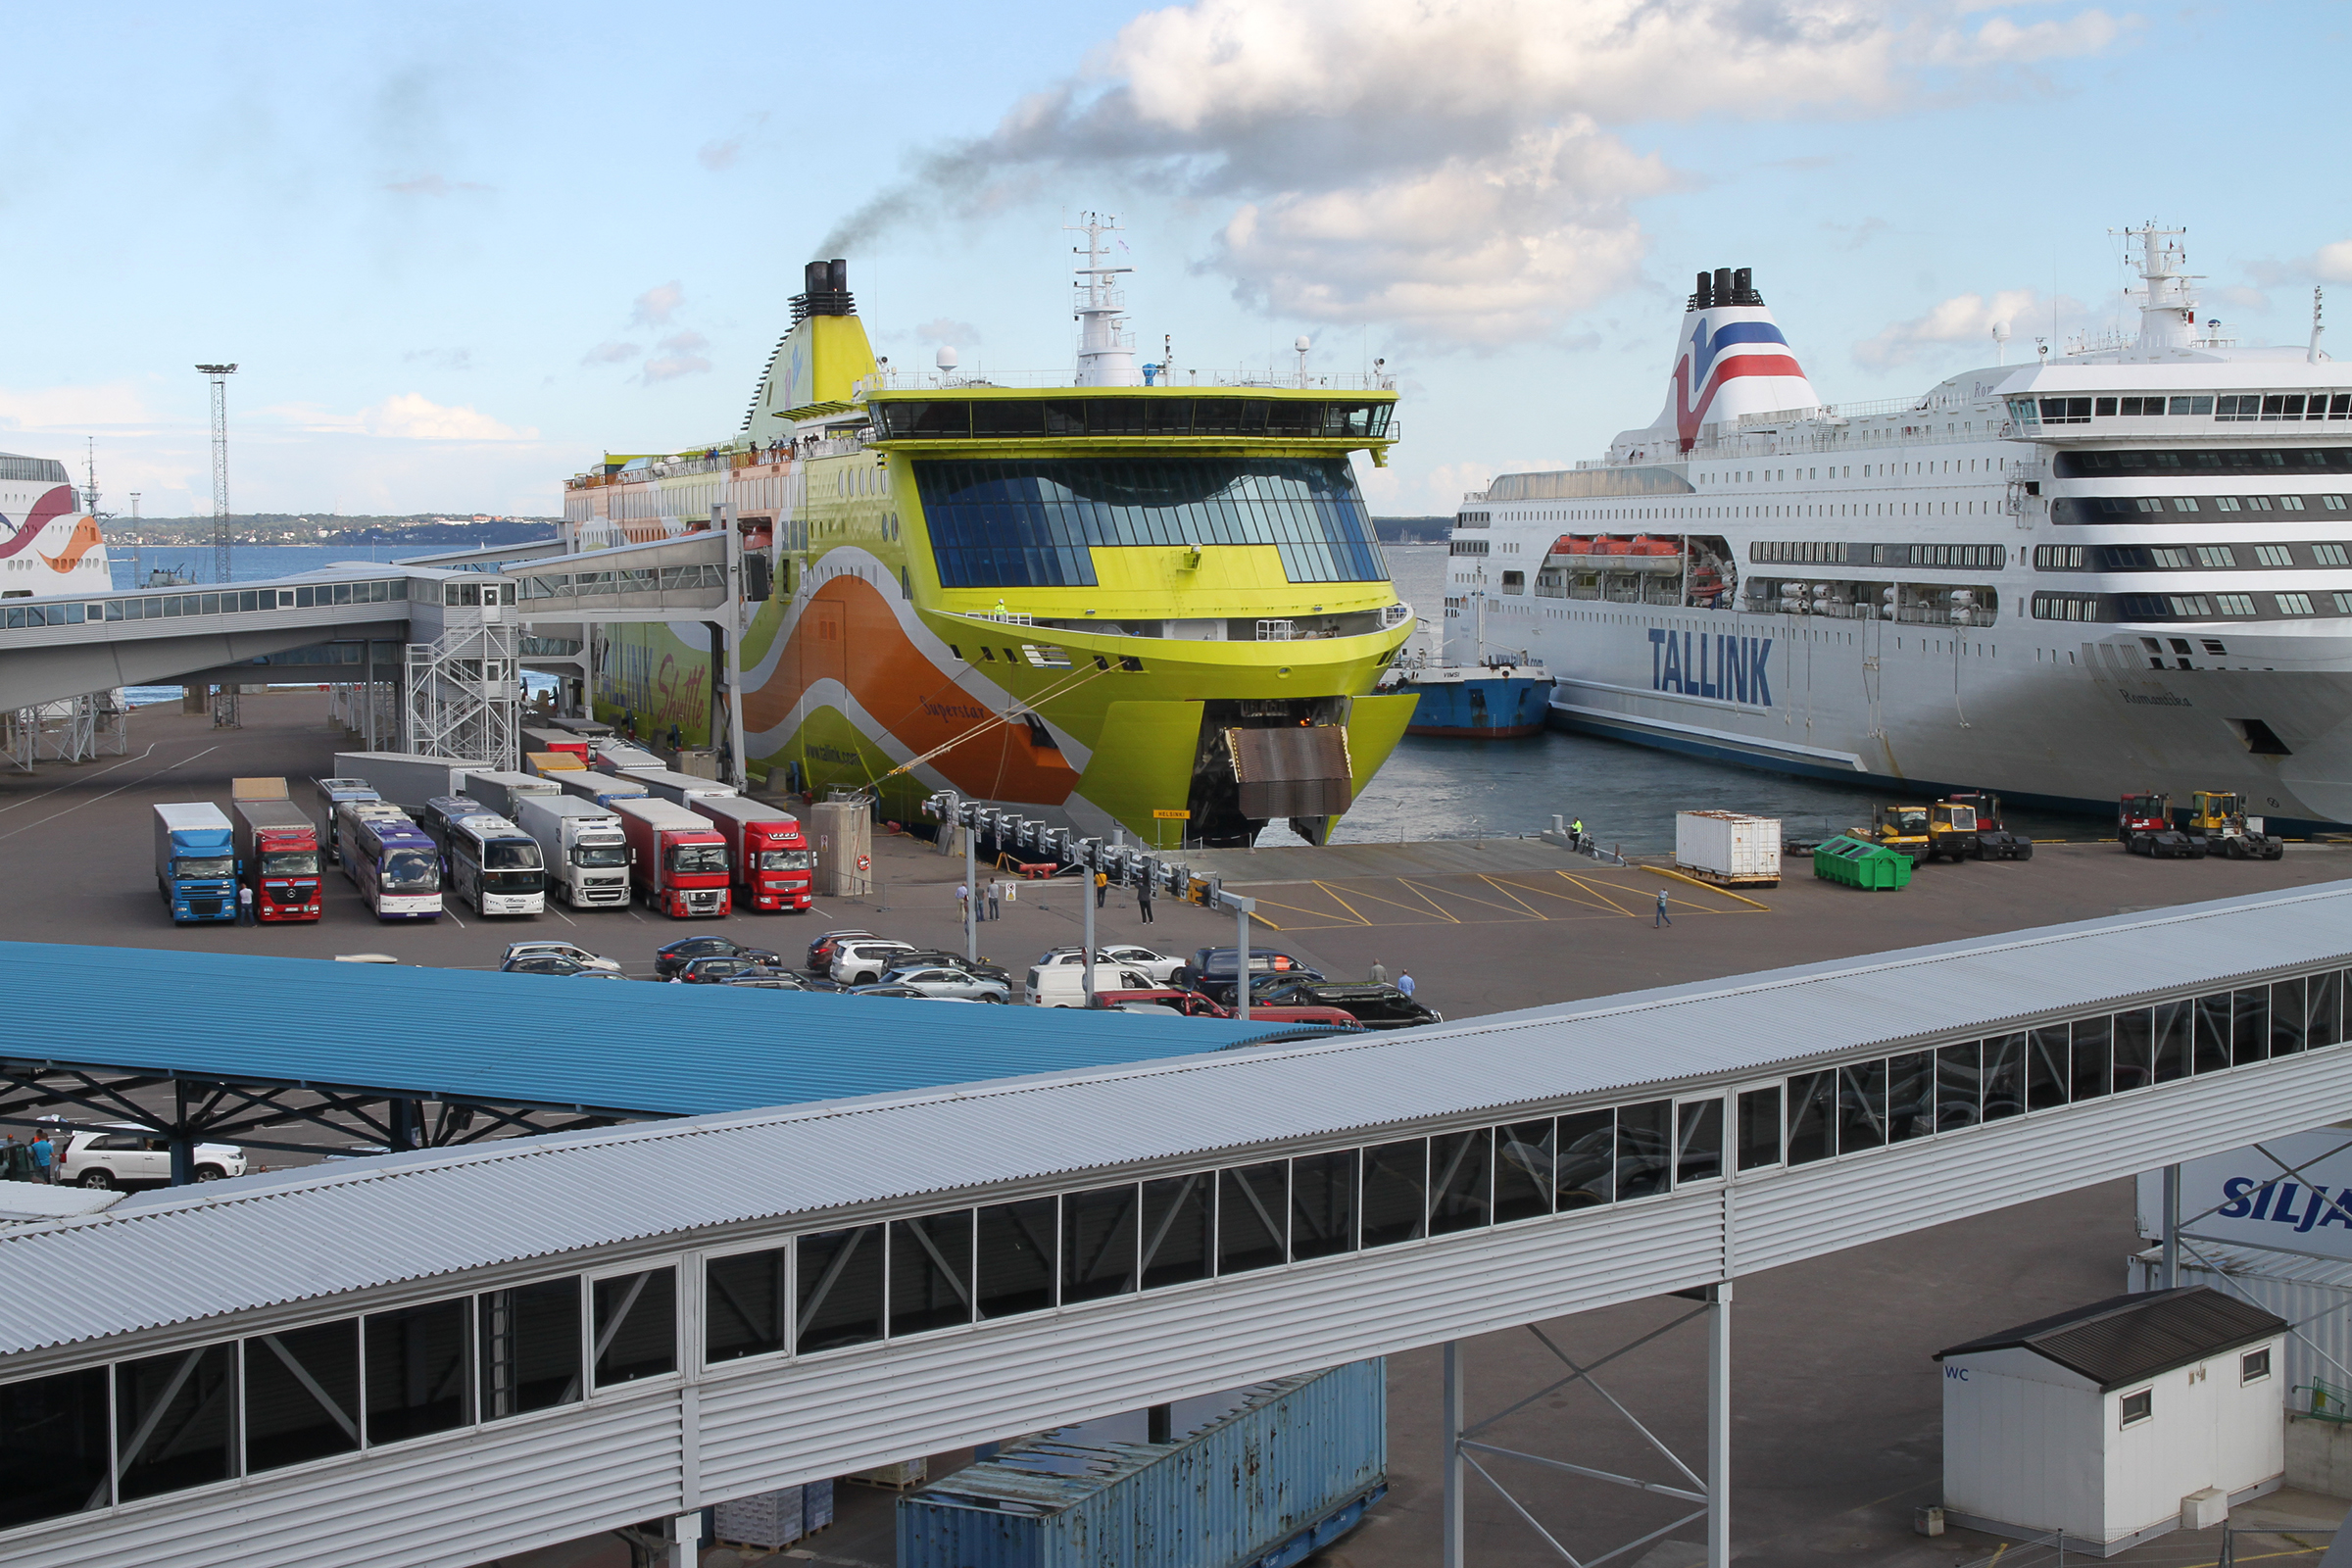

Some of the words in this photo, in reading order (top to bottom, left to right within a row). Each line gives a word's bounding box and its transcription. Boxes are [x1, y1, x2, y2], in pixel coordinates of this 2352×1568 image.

[595, 640, 655, 715] ALLINK
[658, 653, 706, 729] Shuttle
[1648, 628, 1773, 707] TALLINK
[919, 695, 985, 723] Superstar
[2119, 689, 2193, 707] Romantika
[2218, 1177, 2352, 1233] SILJA
[1945, 1365, 1969, 1382] WC
